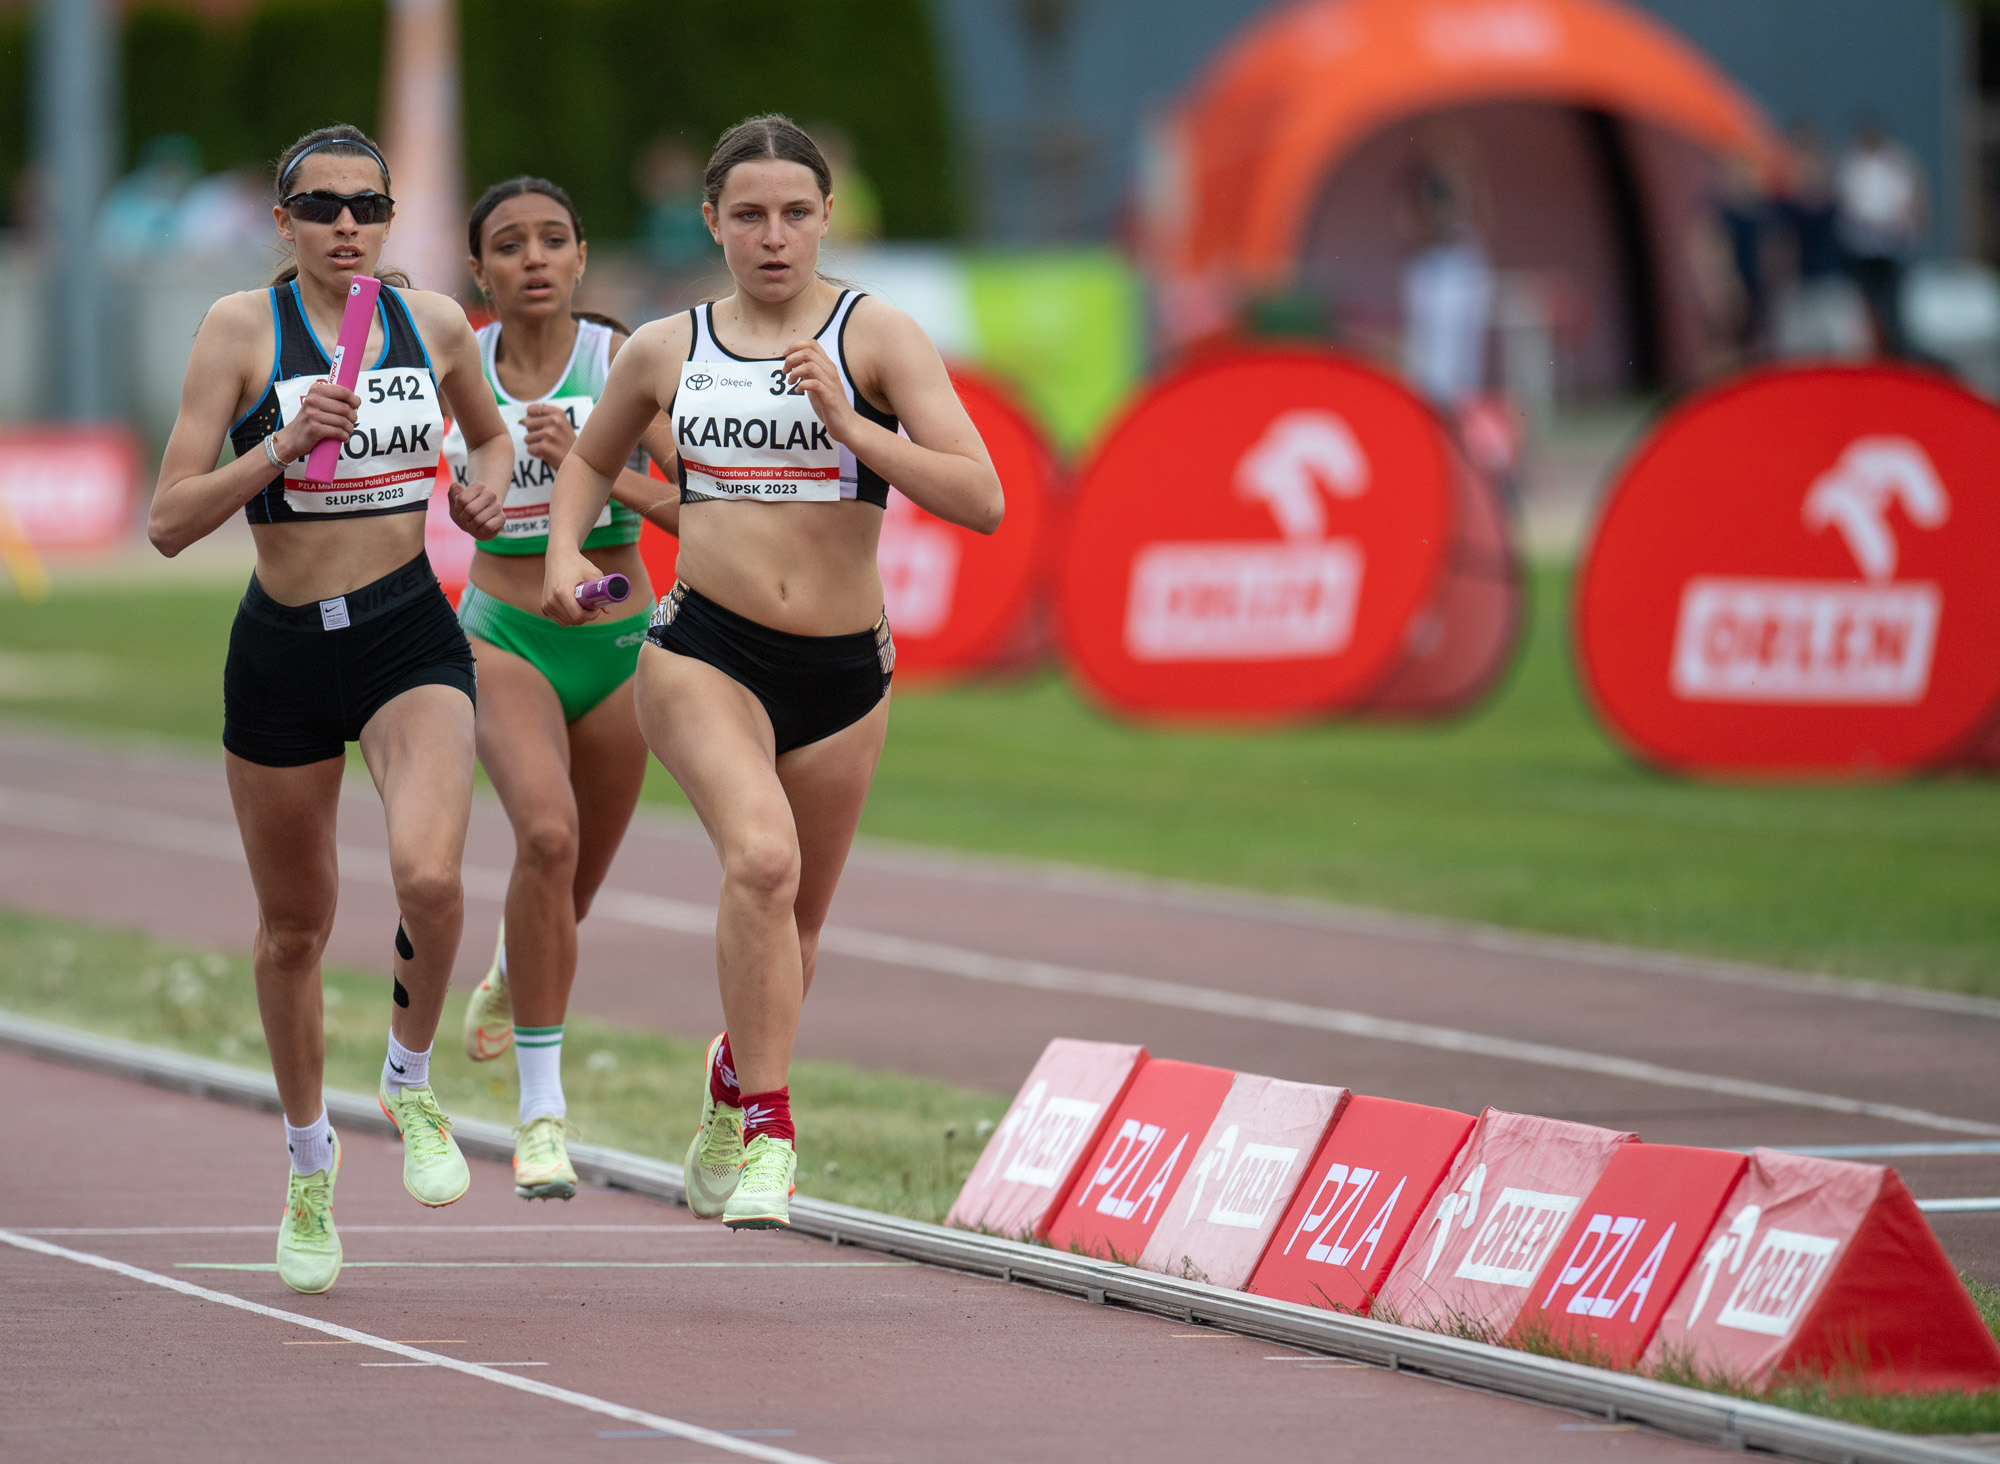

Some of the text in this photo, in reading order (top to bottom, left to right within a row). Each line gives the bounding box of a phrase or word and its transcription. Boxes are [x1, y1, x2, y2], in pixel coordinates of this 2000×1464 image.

[368, 375, 424, 404] 542
[720, 378, 753, 388] Okęcie
[678, 415, 834, 451] KAROLAK
[298, 482, 317, 490] PZLA
[318, 480, 364, 490] Mistrzostwa
[364, 477, 385, 487] Polski
[390, 470, 425, 482] Sztafetach
[325, 487, 404, 506] SŁUPSK 2023
[707, 467, 749, 477] Mistrzostwa
[750, 469, 774, 478] Polski
[783, 469, 826, 479] Sztafetach
[716, 481, 798, 495] SŁUPSK 2023
[1702, 610, 1914, 672] ORLEN
[1078, 1118, 1190, 1224] PZLA
[1218, 1154, 1290, 1216] ORLEN
[1283, 1162, 1407, 1270] PZLA
[1470, 1201, 1568, 1273] ORLEN
[1541, 1214, 1677, 1323] PZLA
[1732, 1245, 1827, 1319] ORLEN
